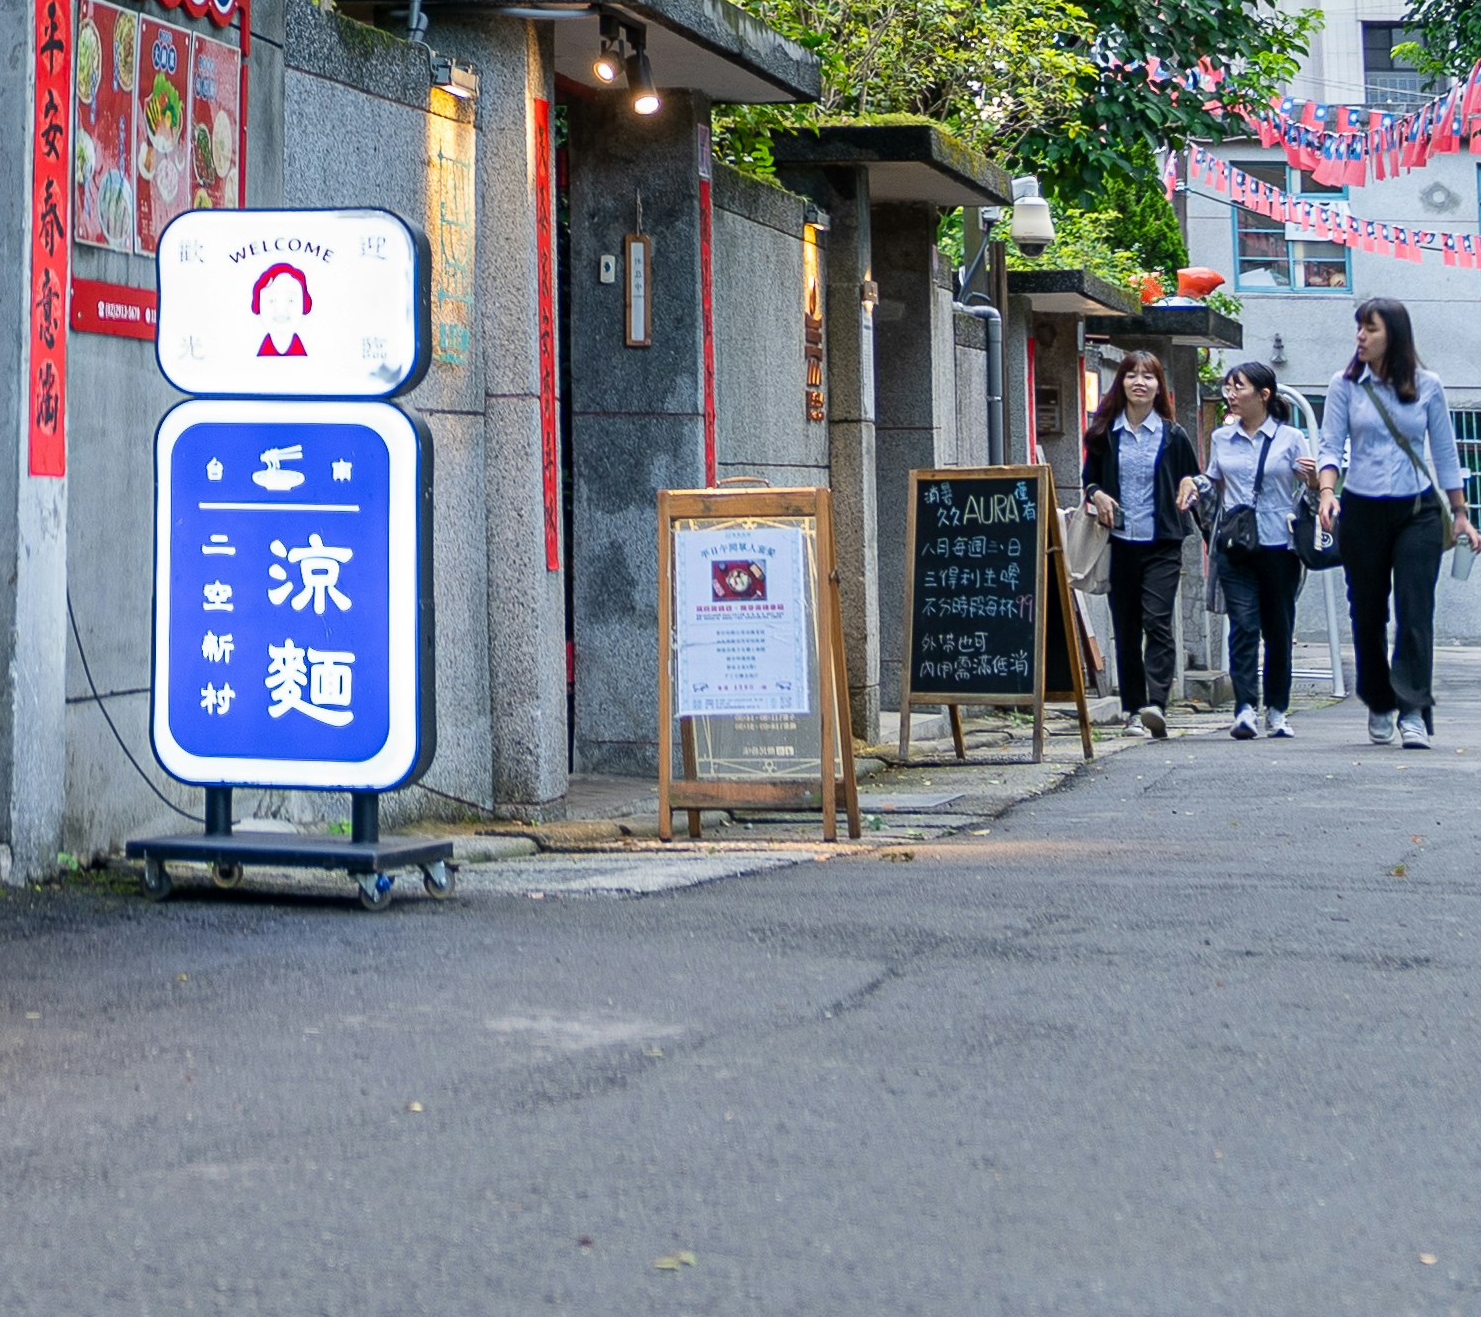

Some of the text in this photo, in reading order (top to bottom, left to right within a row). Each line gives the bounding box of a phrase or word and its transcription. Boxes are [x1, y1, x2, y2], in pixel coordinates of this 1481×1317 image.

[229, 237, 335, 264] WELCOME
[963, 494, 1020, 525] AURA
[200, 534, 237, 715] 二空新村
[264, 533, 357, 728] 涼麵
[921, 631, 989, 653] 外帶也可
